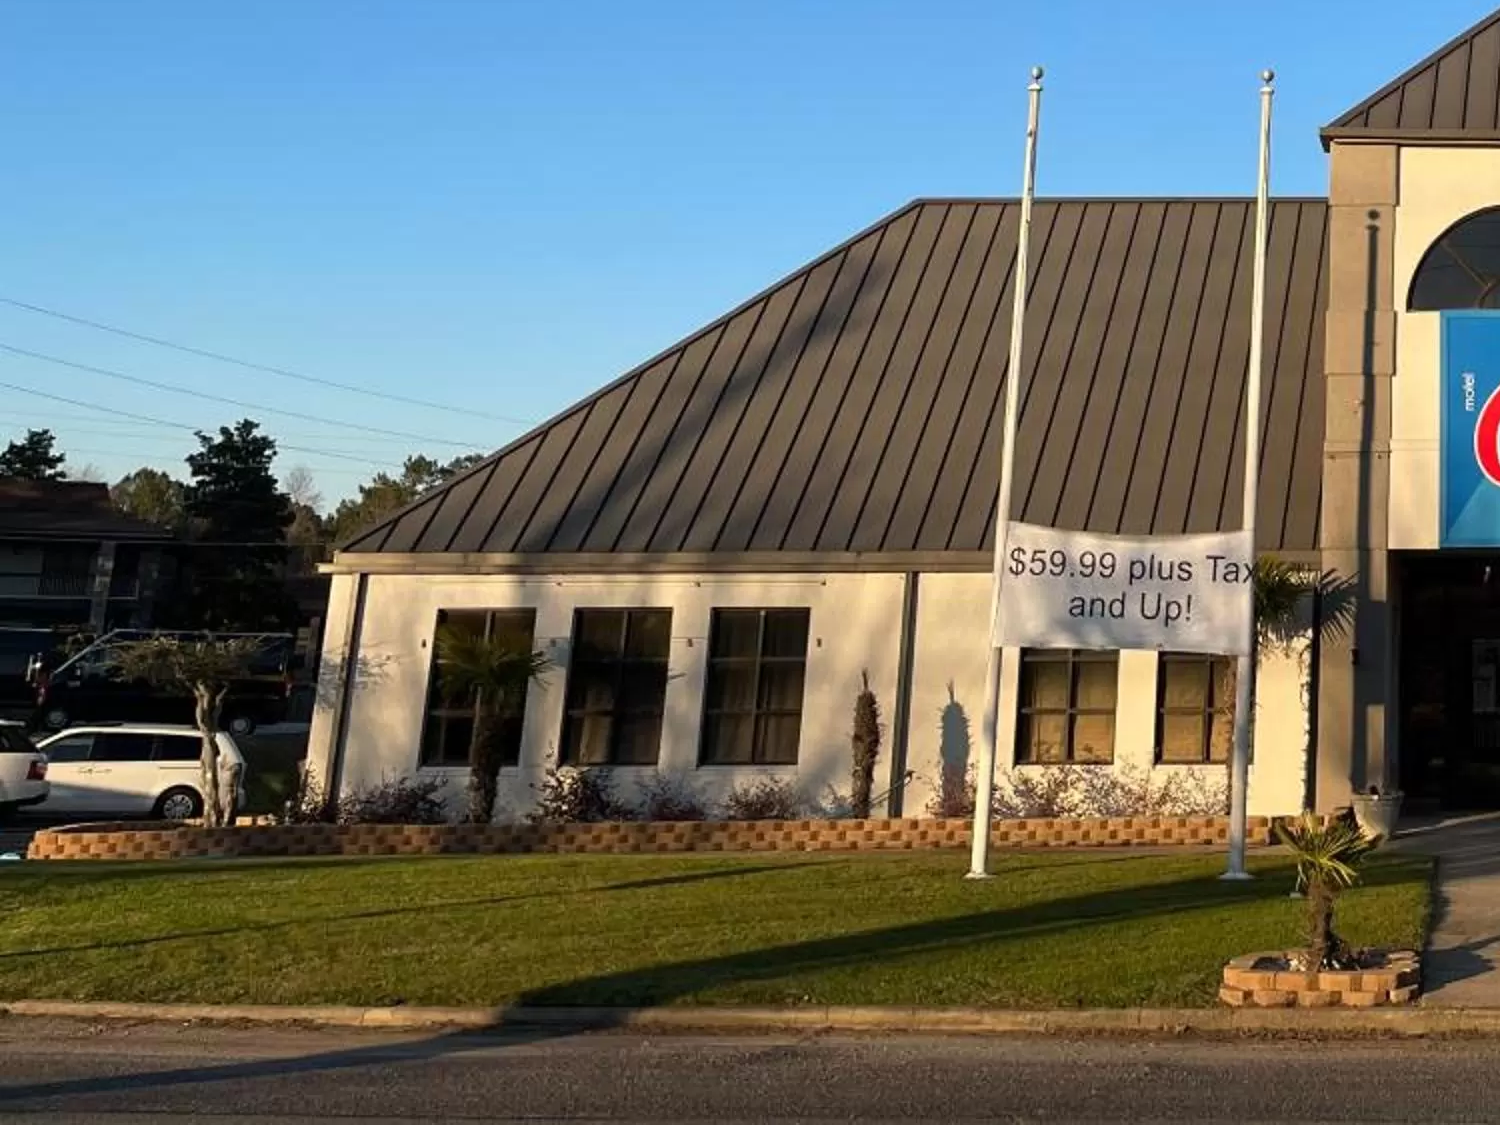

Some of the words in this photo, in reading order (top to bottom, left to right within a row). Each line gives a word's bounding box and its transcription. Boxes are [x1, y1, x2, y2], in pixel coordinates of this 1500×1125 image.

[1462, 372, 1475, 412] motel
[1008, 546, 1117, 579] $59.99
[1129, 554, 1193, 585] plus
[1206, 554, 1257, 584] Tax
[1068, 592, 1126, 619] and
[1140, 593, 1193, 626] Up!
